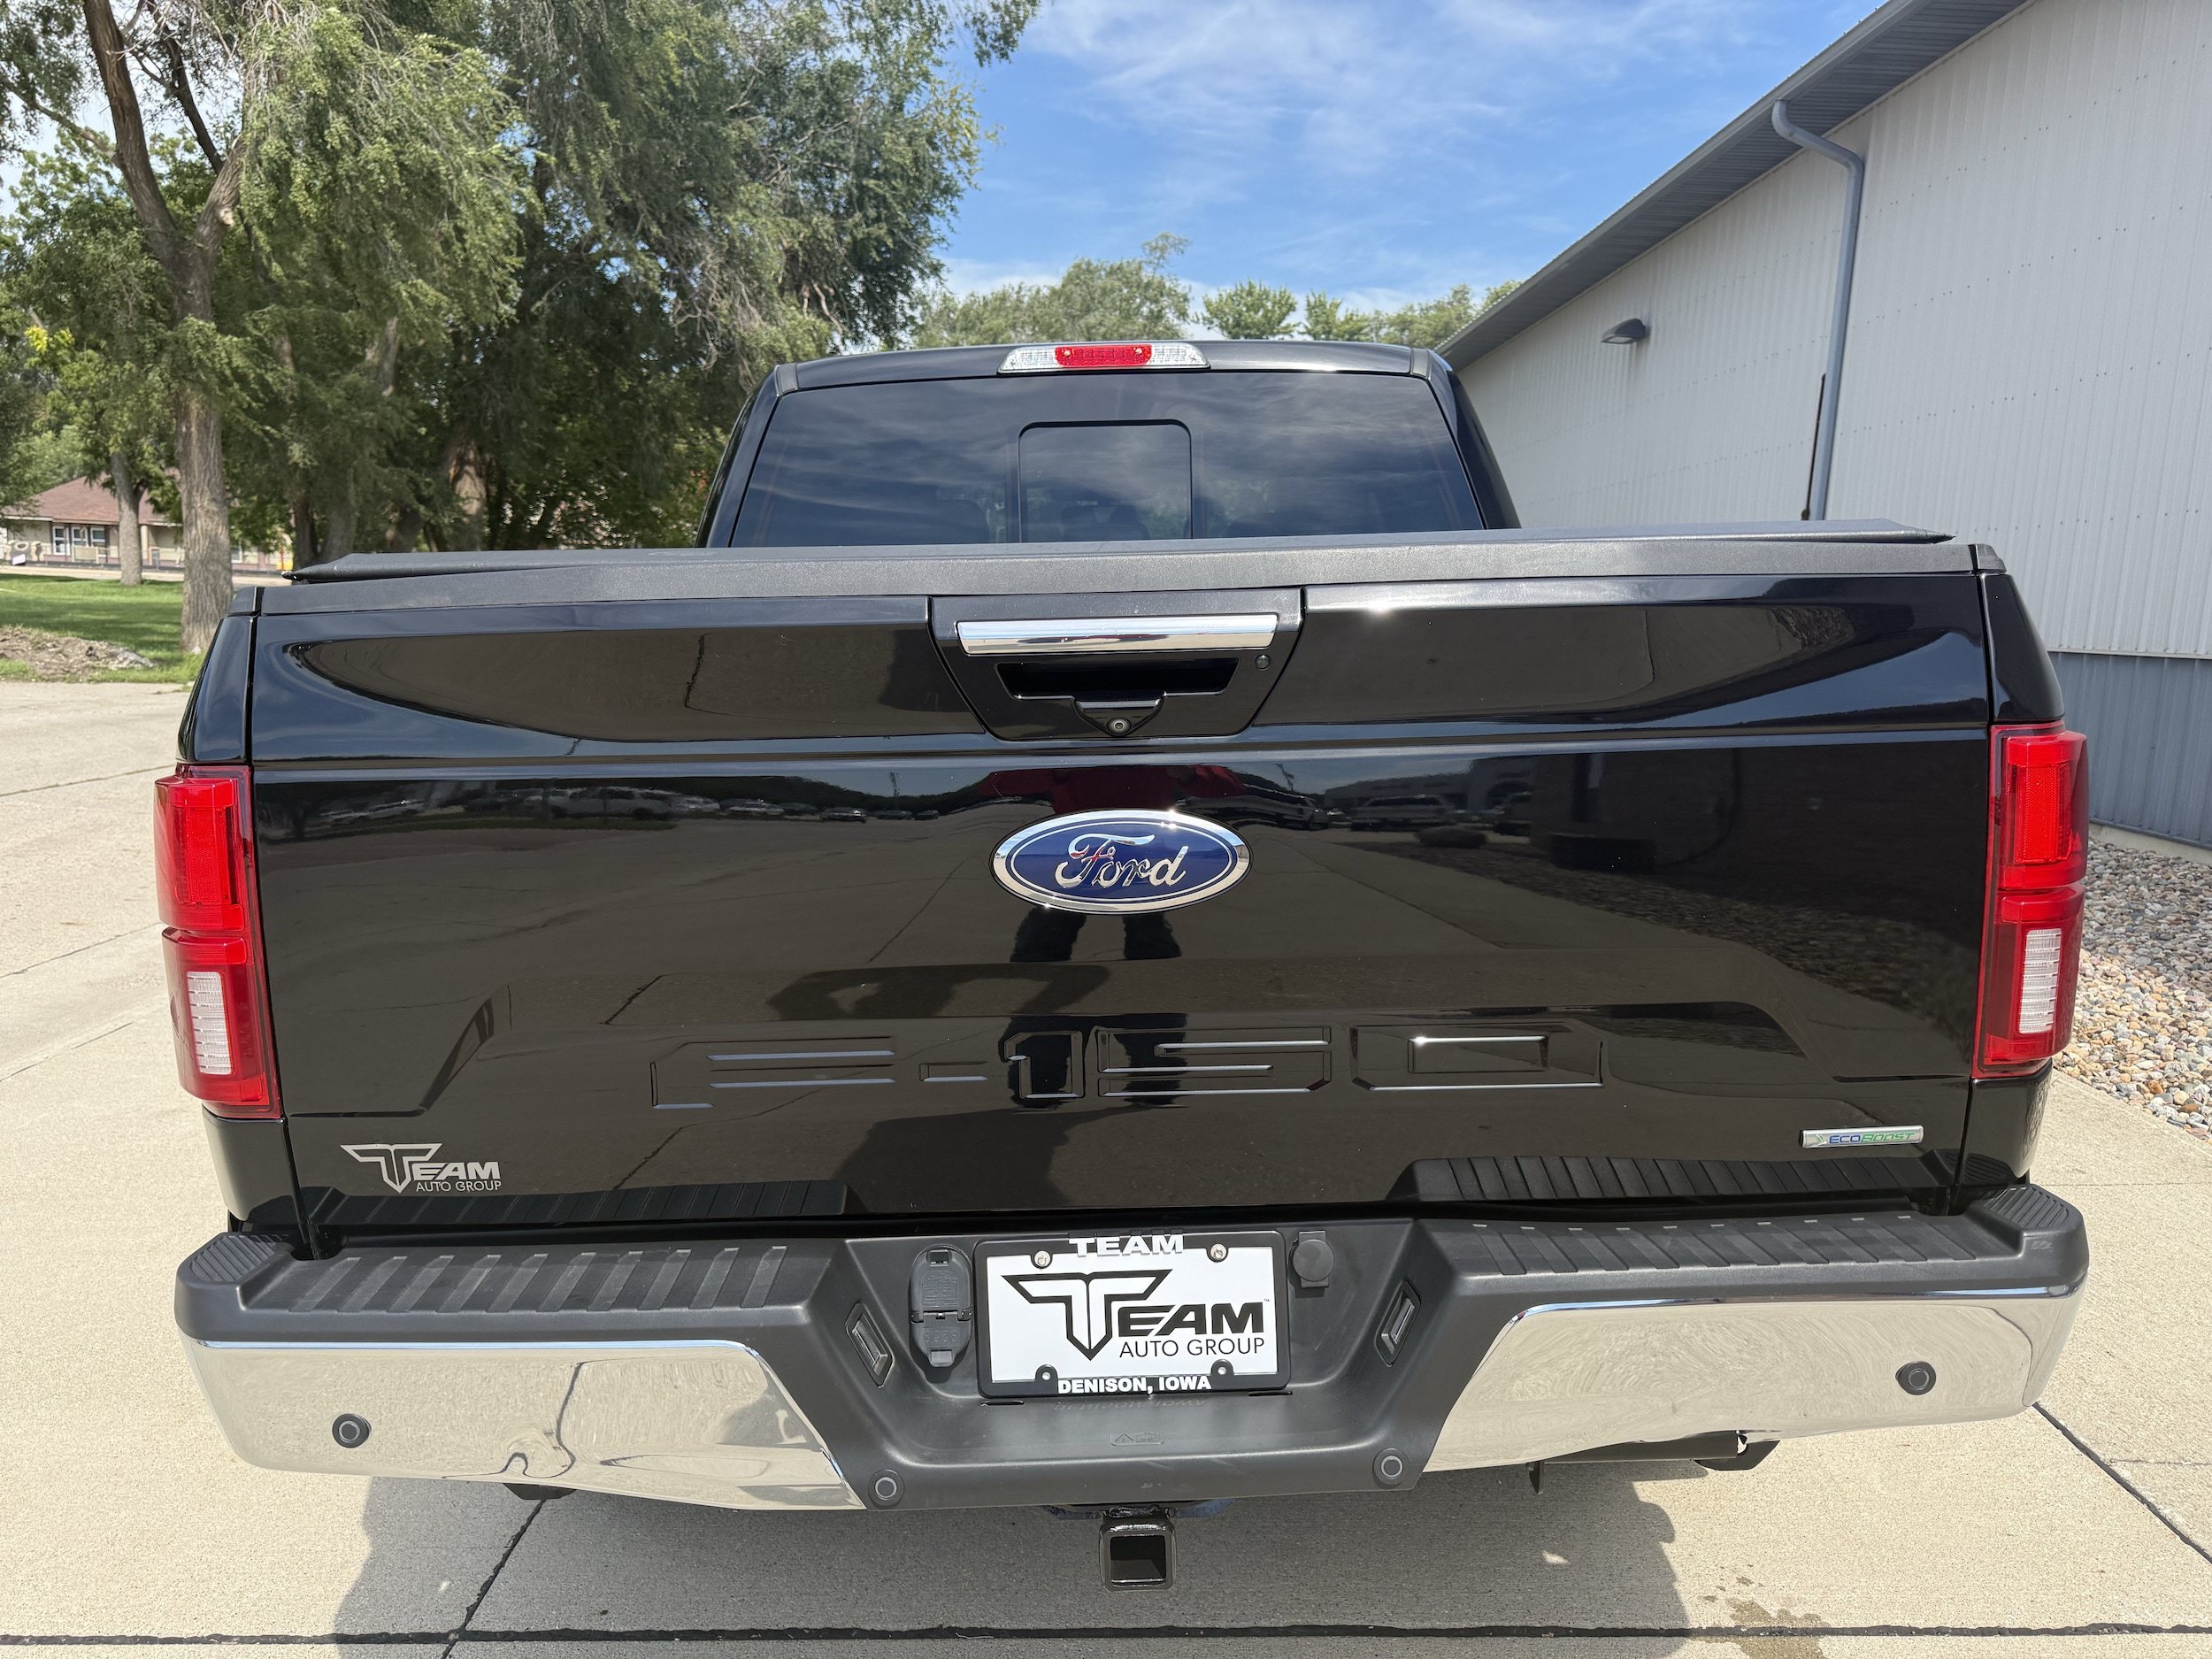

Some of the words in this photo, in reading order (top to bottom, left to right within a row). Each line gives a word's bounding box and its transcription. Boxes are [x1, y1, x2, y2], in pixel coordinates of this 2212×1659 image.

[1055, 833, 1189, 888] Ford
[650, 1021, 1603, 1110] F-150
[340, 1143, 501, 1193] TEAM
[416, 1182, 451, 1192] AUTO
[456, 1181, 502, 1192] GROUP
[1069, 1235, 1184, 1257] TEAM
[1001, 1269, 1264, 1361] TEAM
[1119, 1340, 1179, 1358] AUTO
[1187, 1337, 1265, 1356] GROUP
[1057, 1379, 1153, 1395] DENISON,
[1158, 1376, 1212, 1392] IOWA
